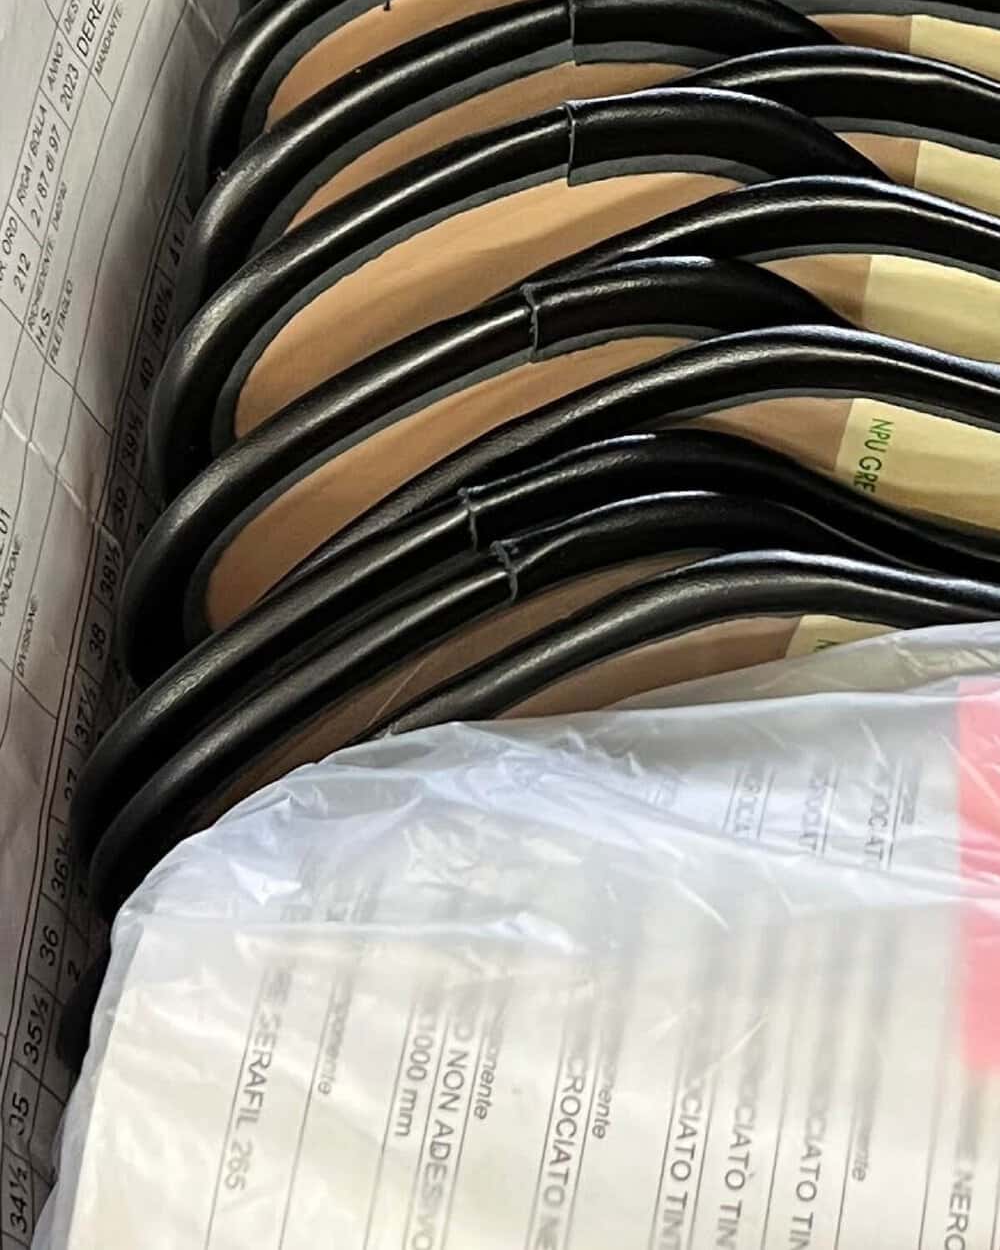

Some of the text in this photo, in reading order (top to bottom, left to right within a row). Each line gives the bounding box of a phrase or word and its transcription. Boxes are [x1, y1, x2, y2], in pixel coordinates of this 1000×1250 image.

[60, 62, 79, 112] 2023
[13, 252, 31, 294] 212
[864, 417, 894, 453] NPU
[89, 623, 107, 661] 38
[39, 924, 59, 967] 36
[236, 1012, 282, 1130] SERAFIL
[438, 1049, 469, 1113] NON
[8, 1092, 30, 1137] 35
[394, 1087, 419, 1138] mm
